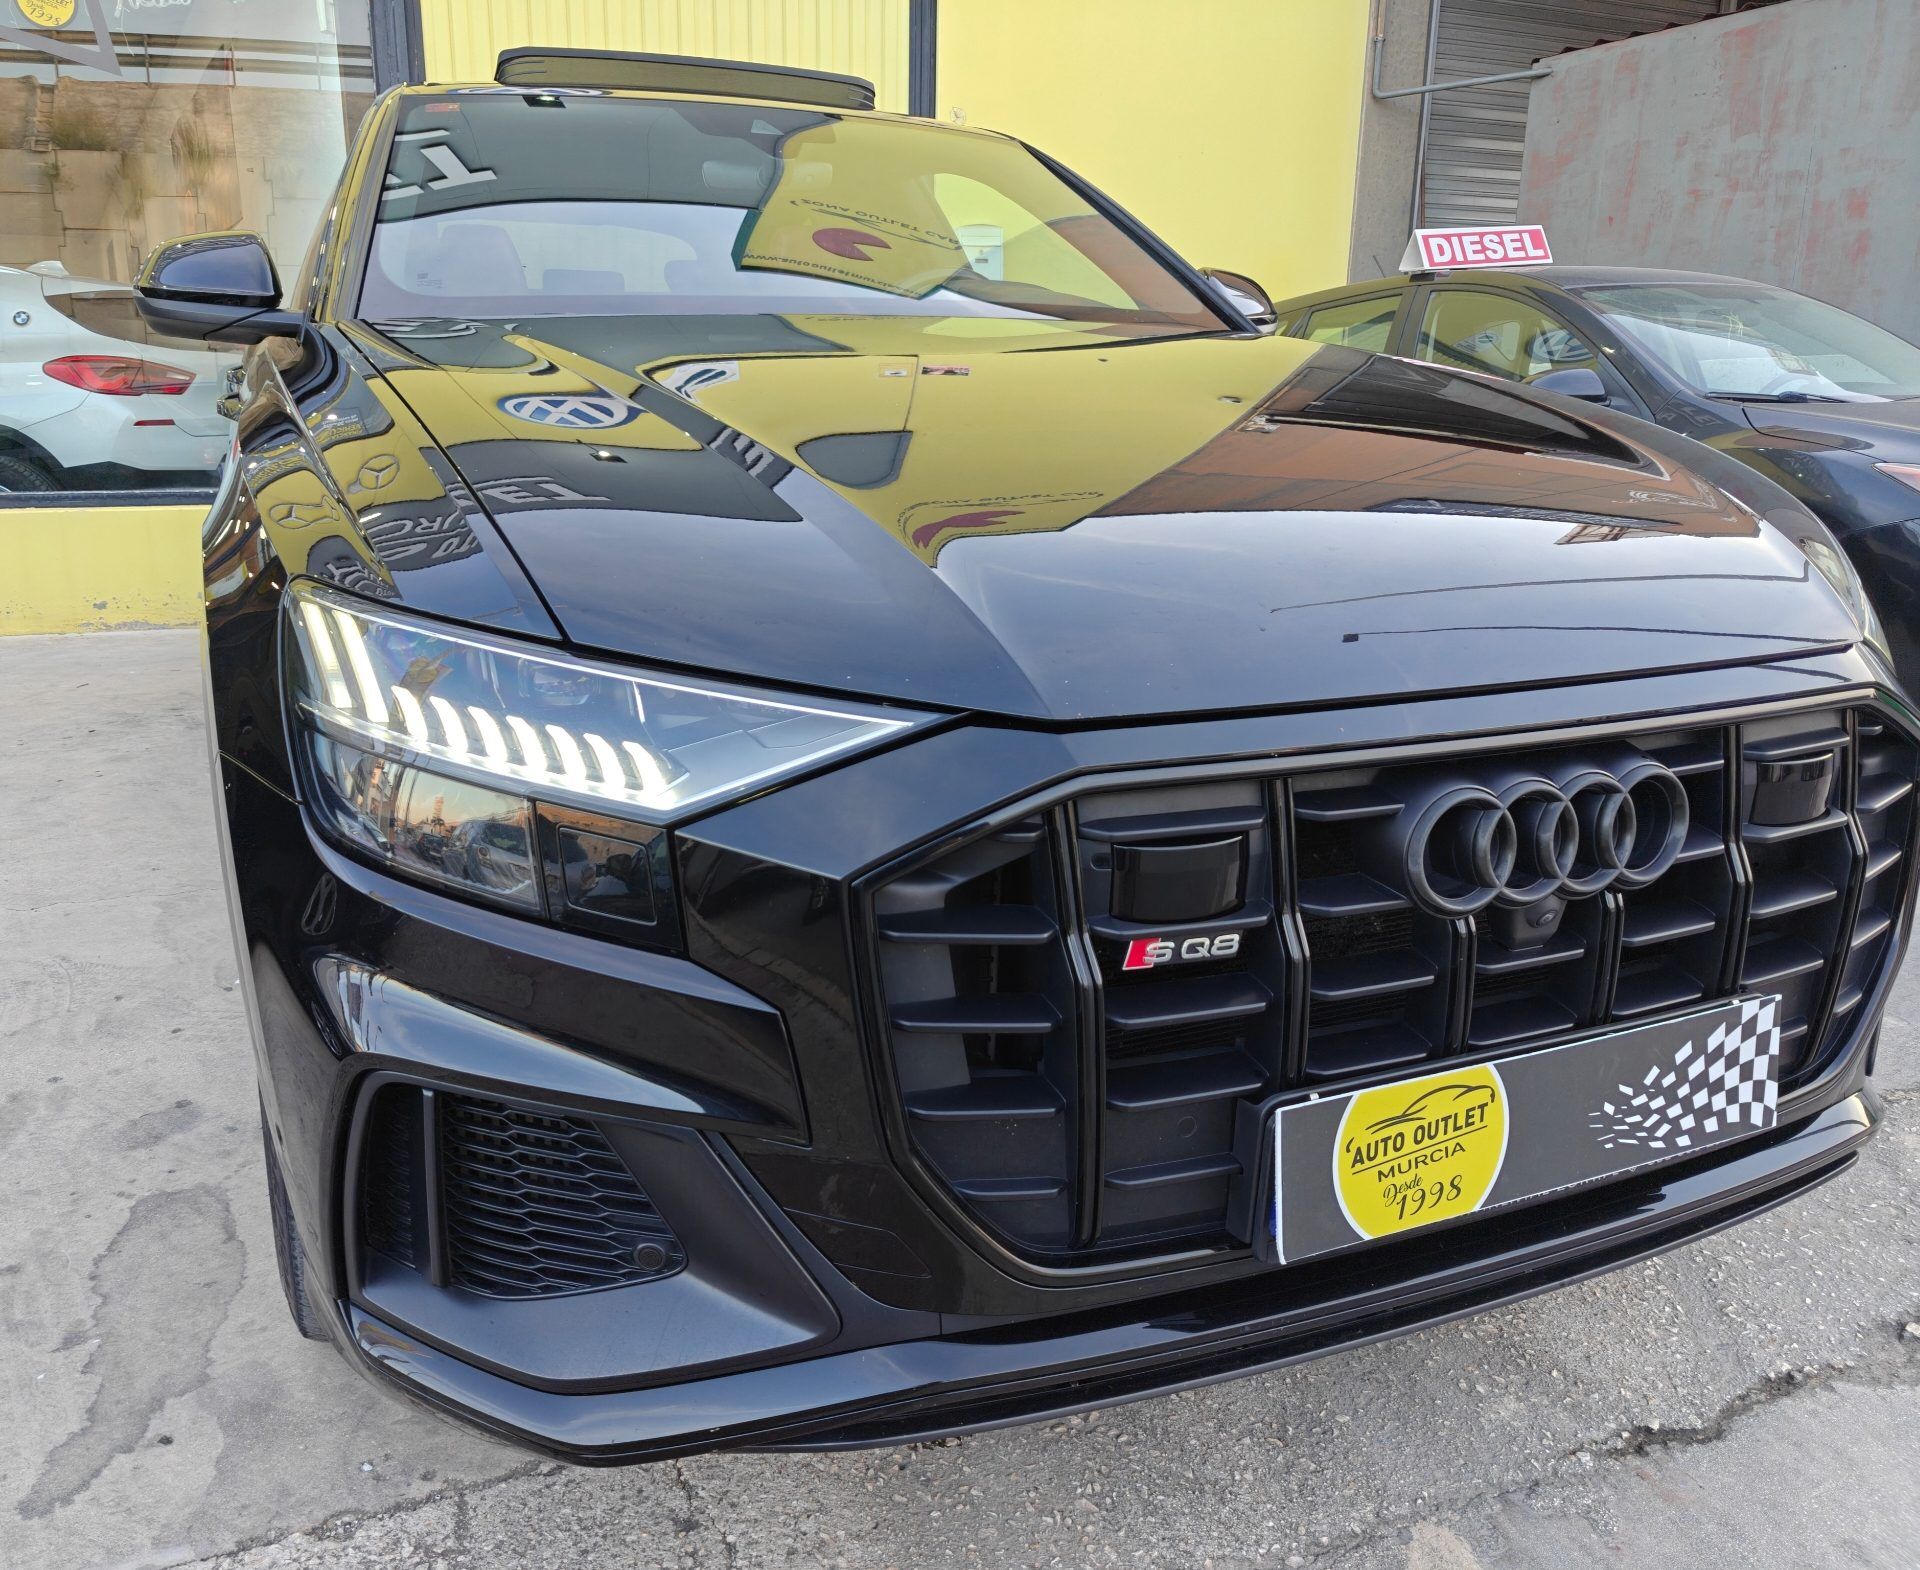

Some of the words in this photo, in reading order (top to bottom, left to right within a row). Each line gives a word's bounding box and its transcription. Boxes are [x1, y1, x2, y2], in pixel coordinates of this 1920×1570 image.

[1428, 232, 1546, 264] DIESEL
[1377, 1141, 1467, 1183] MURCIA
[1383, 1173, 1424, 1208] Desde
[1396, 1174, 1464, 1221] 1998
